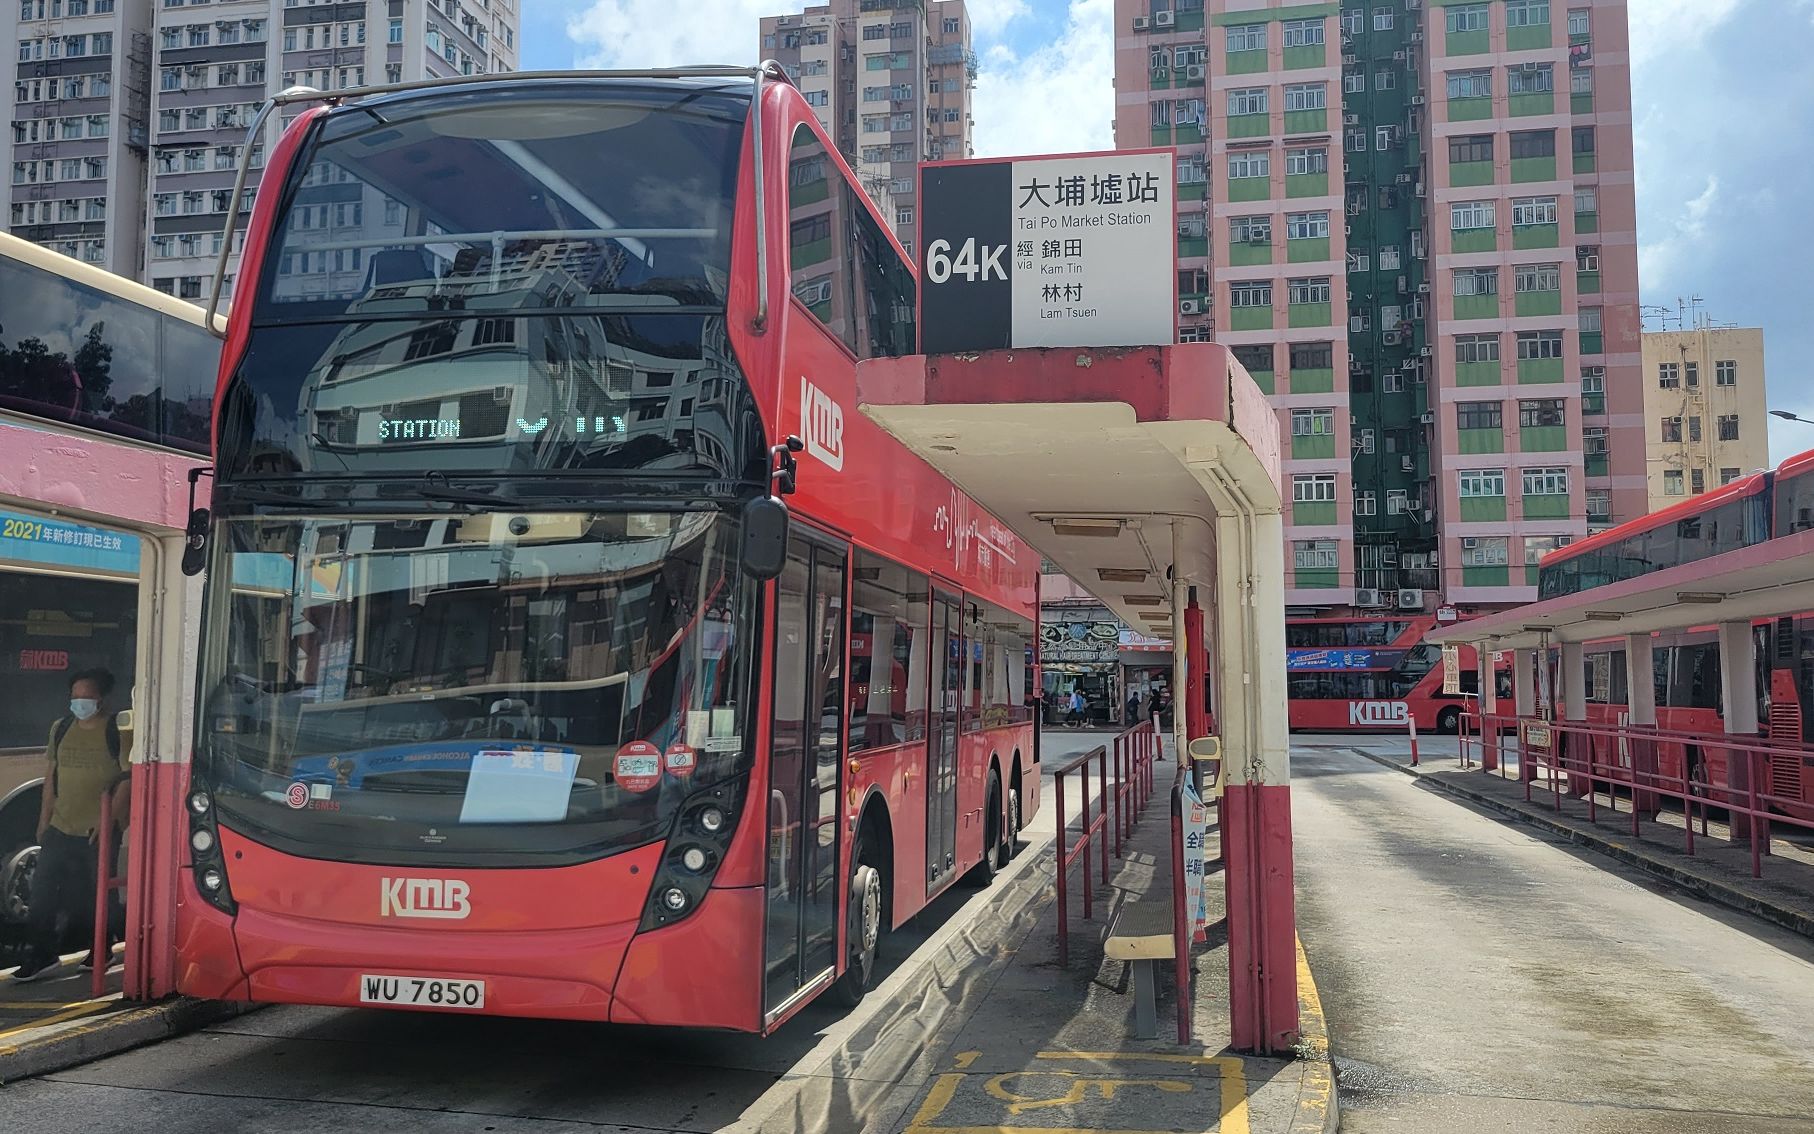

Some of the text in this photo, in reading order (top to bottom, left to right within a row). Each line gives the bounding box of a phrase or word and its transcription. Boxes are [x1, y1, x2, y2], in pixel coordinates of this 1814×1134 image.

[1018, 172, 1159, 209] 大埔墟站
[1018, 211, 1151, 230] Tai Po Market Station
[1016, 239, 1083, 259] 經 錦田
[926, 237, 1009, 284] 64K
[1017, 260, 1033, 270] via
[1040, 263, 1083, 275] Kam Tin
[1041, 282, 1083, 303] 林村
[1040, 307, 1097, 320] Lam Tsuen
[378, 419, 460, 438] STATION
[801, 376, 844, 472] KMB
[1349, 701, 1409, 725] KMB
[381, 877, 471, 919] KMB
[366, 976, 480, 1006] WU 7850
